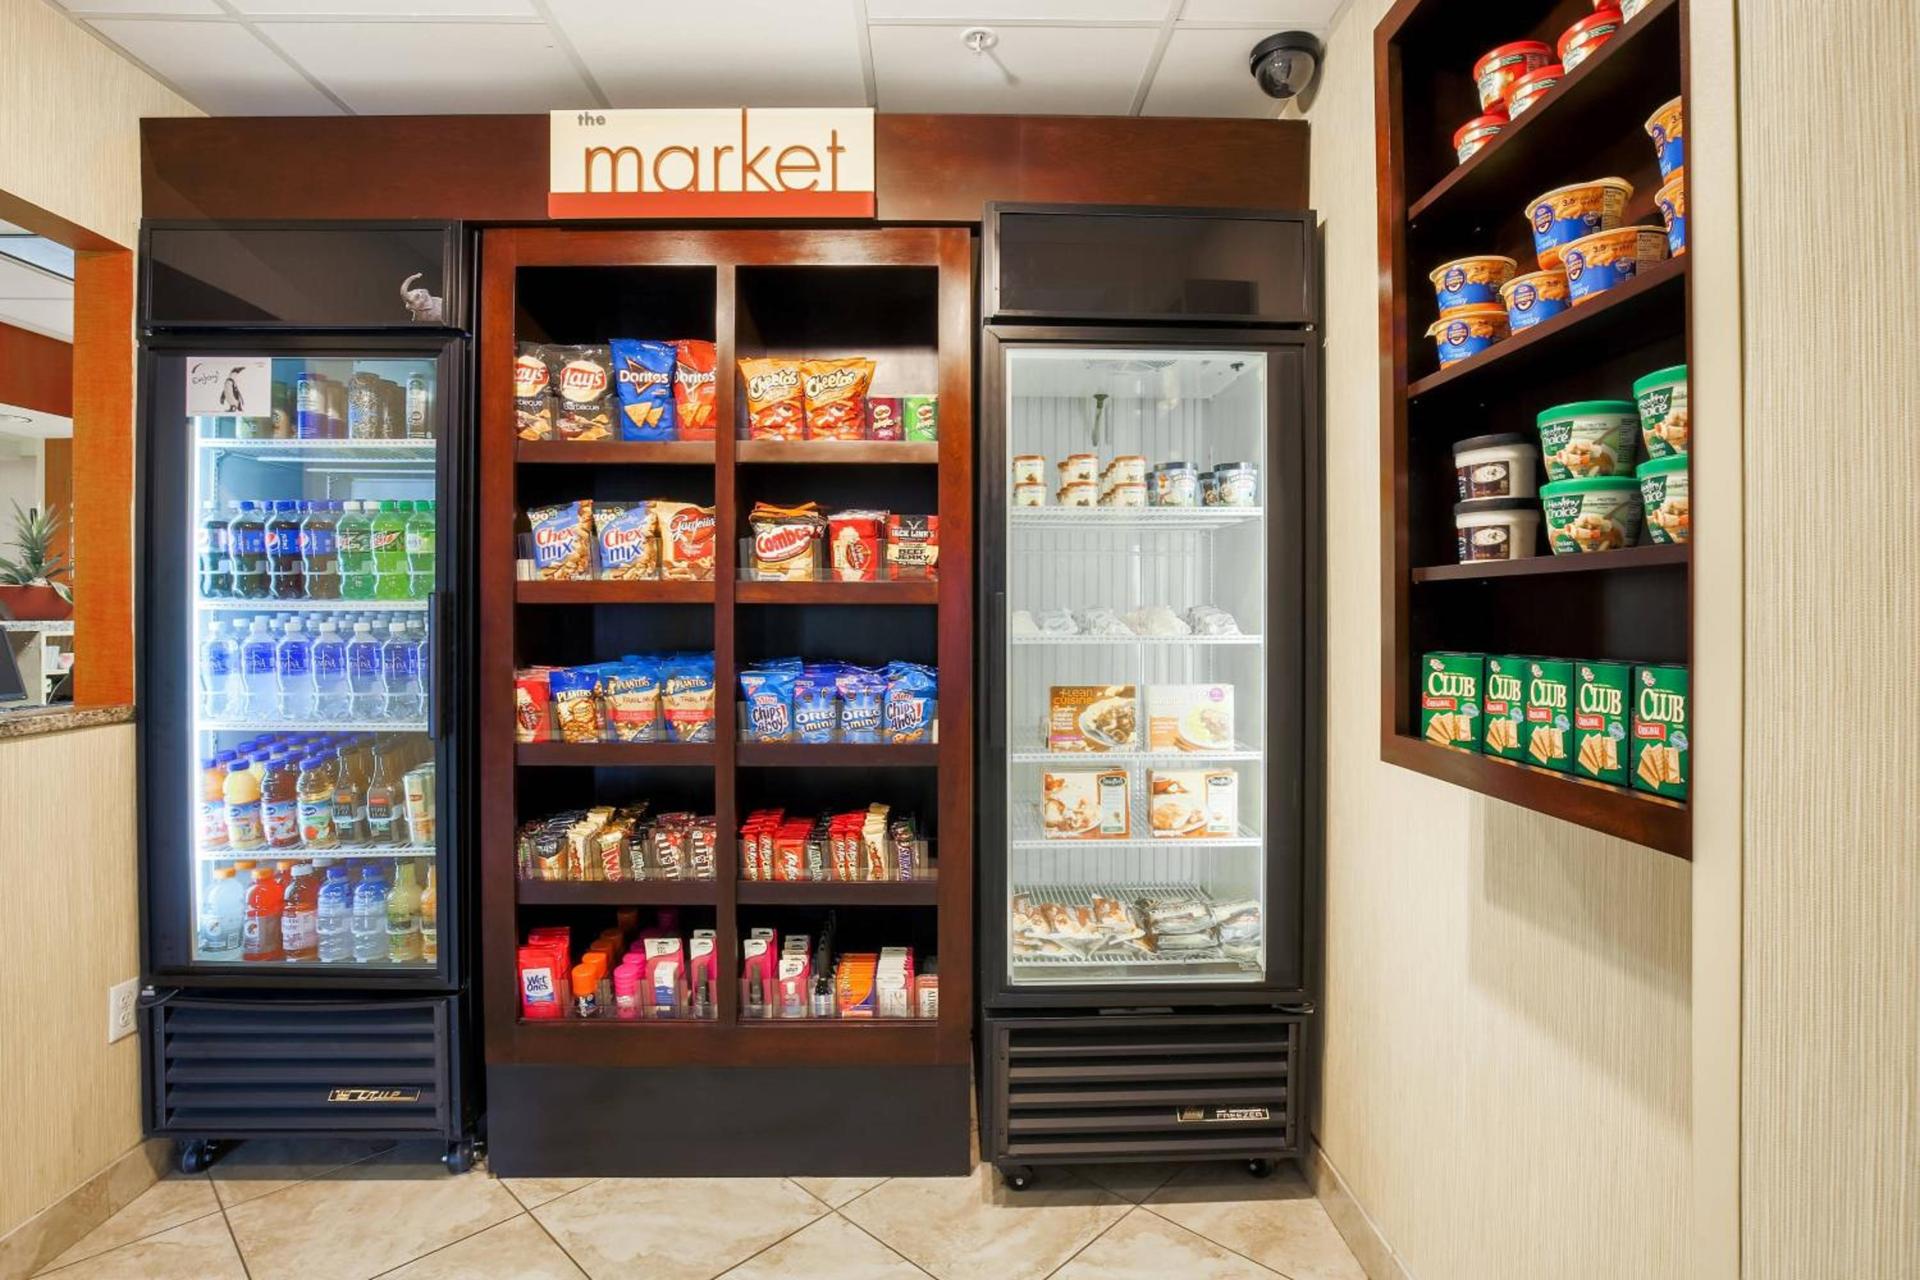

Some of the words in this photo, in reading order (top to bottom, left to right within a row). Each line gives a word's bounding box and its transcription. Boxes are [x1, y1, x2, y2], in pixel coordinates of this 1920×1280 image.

[578, 112, 606, 126] the
[585, 107, 846, 193] market
[619, 369, 669, 384] Doritos
[749, 369, 797, 402] Cheetos
[805, 369, 854, 400] Cheetos
[535, 528, 574, 547] Chex
[603, 529, 643, 548] Chex
[609, 542, 643, 563] mix
[1428, 671, 1477, 697] CLUB
[1489, 674, 1523, 701] CLUB
[1530, 679, 1569, 708] CLUB
[1581, 683, 1624, 715] CLUB
[1641, 688, 1687, 723] CLUB
[752, 704, 781, 721] Chips
[804, 720, 832, 733] mini
[848, 718, 876, 731] mini
[526, 974, 547, 986] Wet
[526, 983, 550, 993] Ones
